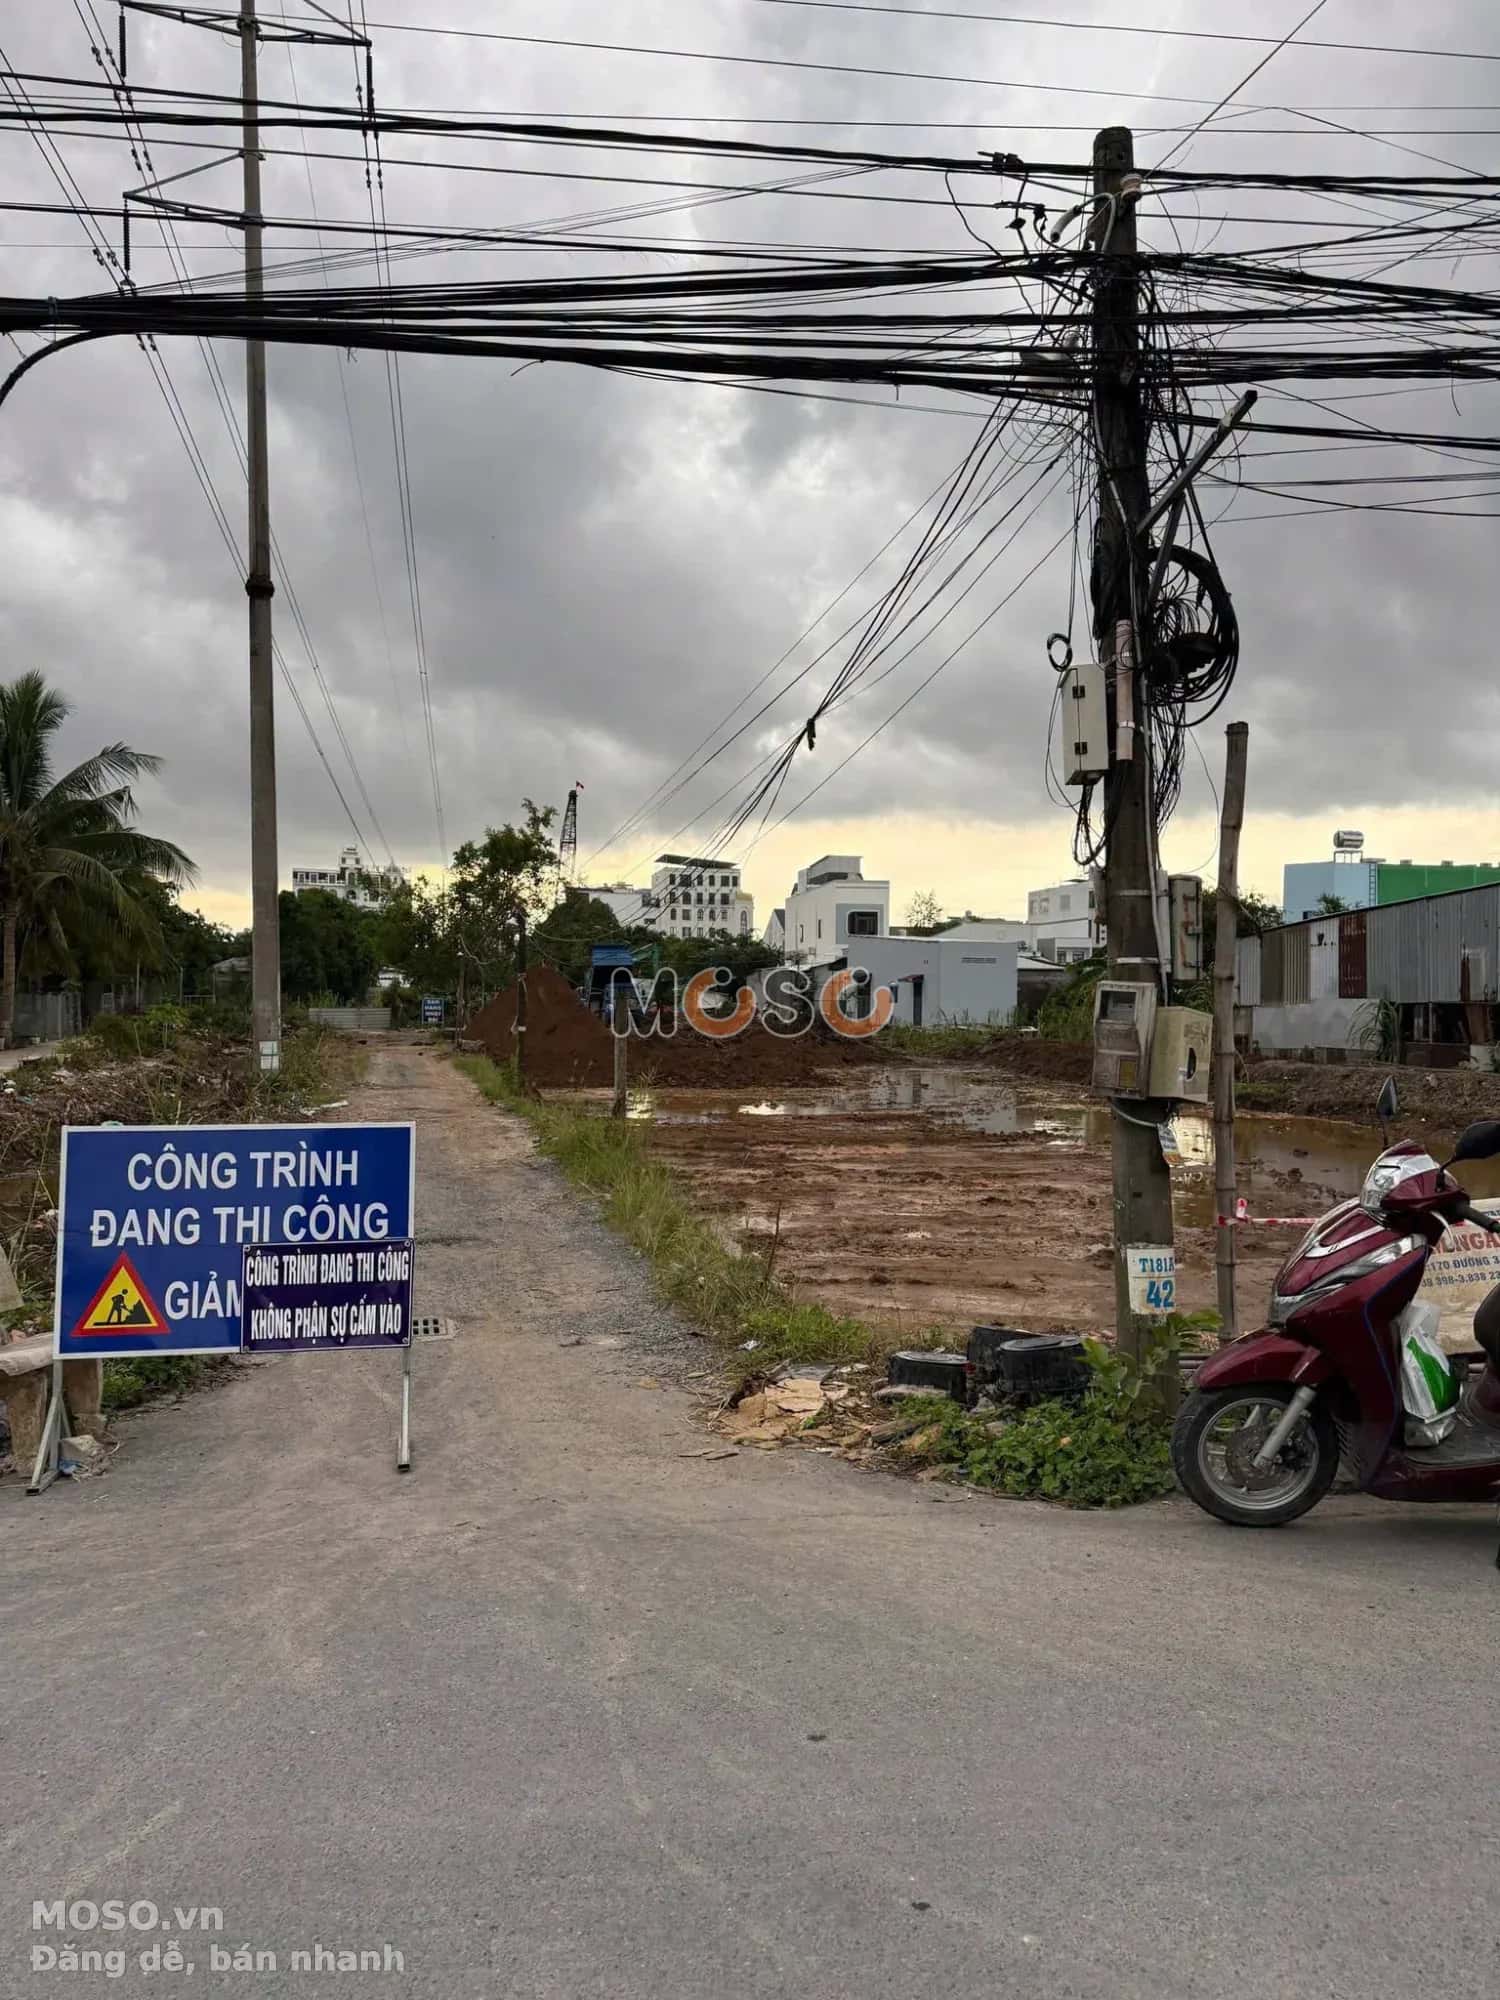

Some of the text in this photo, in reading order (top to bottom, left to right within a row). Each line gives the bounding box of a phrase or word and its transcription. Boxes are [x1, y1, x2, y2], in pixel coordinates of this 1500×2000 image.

[127, 1141, 359, 1191] CÔNG TRÌNH
[90, 1194, 389, 1247] ĐANG THI CÔNG
[246, 1245, 409, 1287] CÔNG TRÌNH ĐANG THI CÔNG
[251, 1293, 402, 1344] KHÔNG PHẬN SỰ CẤM VÀO
[1146, 1280, 1175, 1308] 42
